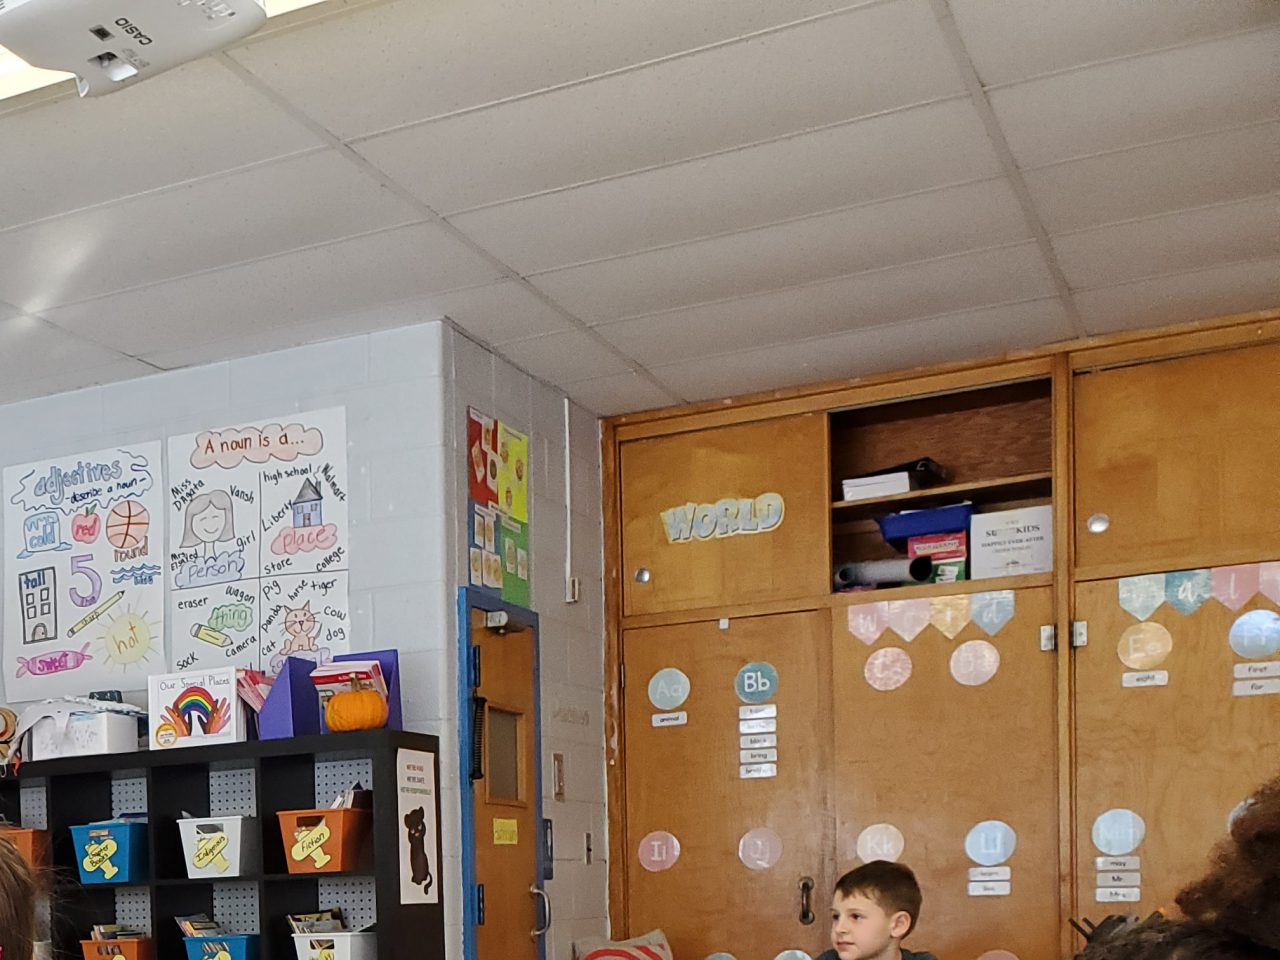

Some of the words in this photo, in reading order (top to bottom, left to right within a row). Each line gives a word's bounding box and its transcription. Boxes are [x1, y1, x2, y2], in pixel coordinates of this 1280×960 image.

[114, 17, 153, 46] CASIO
[204, 438, 215, 456] A
[220, 436, 252, 453] noun
[258, 434, 270, 447] is
[34, 460, 123, 506] adjectives
[263, 467, 283, 486] high
[286, 463, 313, 480] school
[320, 462, 348, 502] Walmart
[170, 478, 192, 500] Miss
[75, 517, 98, 537] red
[261, 499, 294, 533] Liberty
[661, 493, 784, 542] WORLD
[29, 522, 56, 549] cold
[283, 524, 327, 552] place
[1016, 524, 1040, 534] KIDS
[114, 535, 149, 563] round
[236, 530, 257, 552] girl
[23, 569, 45, 591] tall
[68, 553, 103, 608] 5
[187, 559, 240, 584] Person
[225, 585, 255, 605] wagon
[262, 579, 282, 601] pig
[288, 578, 308, 601] horse
[310, 578, 338, 597] tiger
[178, 596, 208, 610] eraser
[81, 611, 100, 628] sharp
[214, 607, 249, 633] thing
[261, 604, 283, 634] panda
[113, 620, 138, 655] hot
[325, 626, 347, 643] dog
[225, 635, 257, 658] camera
[261, 640, 277, 656] cat
[1128, 635, 1161, 659] Ee
[37, 652, 70, 673] sweet
[176, 651, 200, 671] sock
[160, 681, 175, 690] Our
[208, 675, 230, 685] Places
[656, 680, 683, 698] Aa
[744, 671, 771, 693] Bb
[301, 832, 325, 853] Fiction
[650, 840, 667, 862] Ii
[866, 843, 893, 855] Kk
